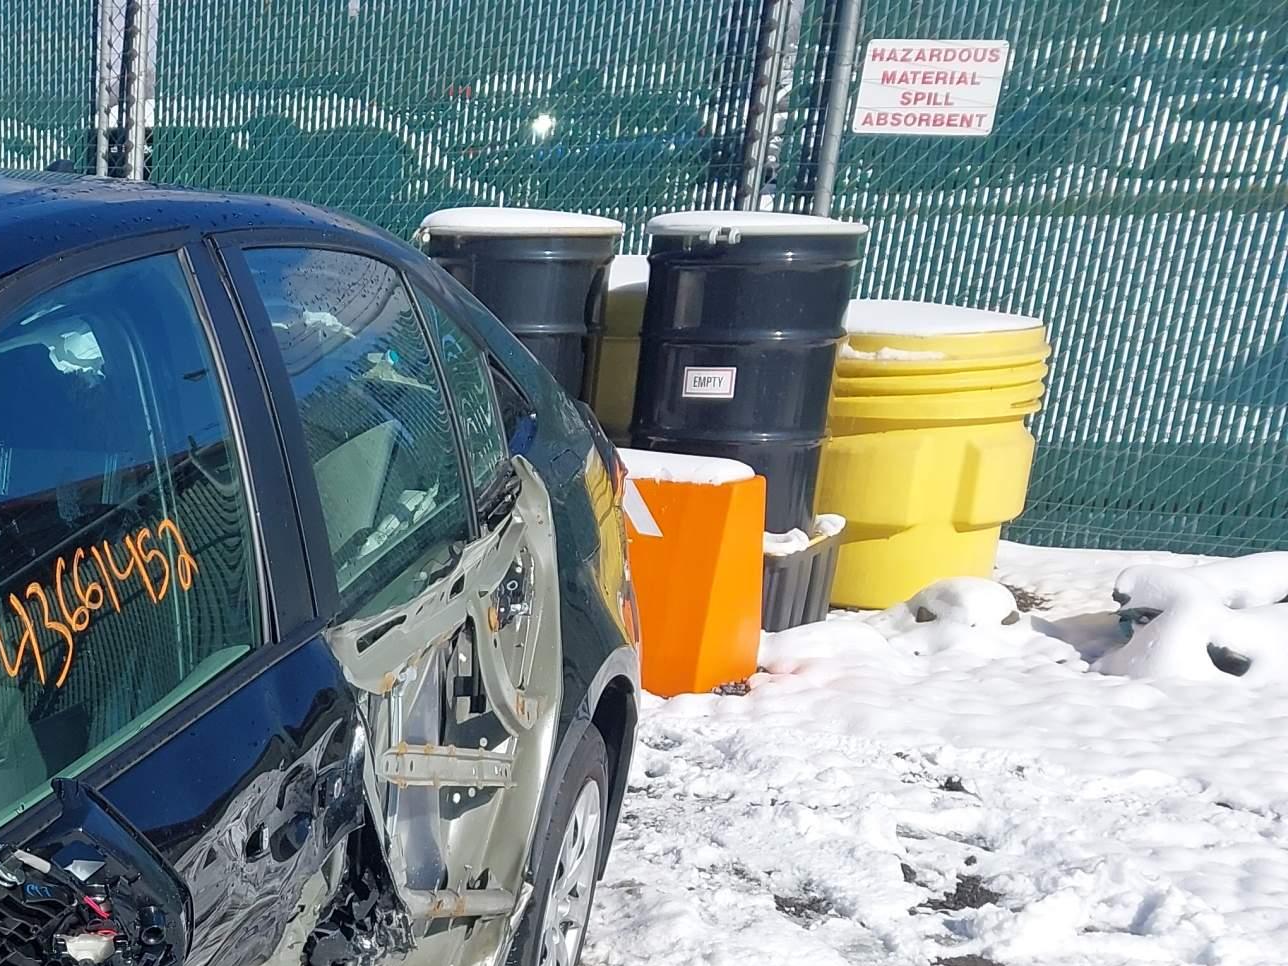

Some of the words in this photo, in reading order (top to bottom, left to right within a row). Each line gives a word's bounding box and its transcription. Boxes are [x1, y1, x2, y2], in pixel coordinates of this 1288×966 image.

[871, 47, 1001, 63] HAZARDOUS
[881, 70, 982, 86] MATERIAL
[900, 92, 955, 107] SPILL
[862, 113, 987, 129] ABSORBENT
[693, 375, 724, 388] EMPTY
